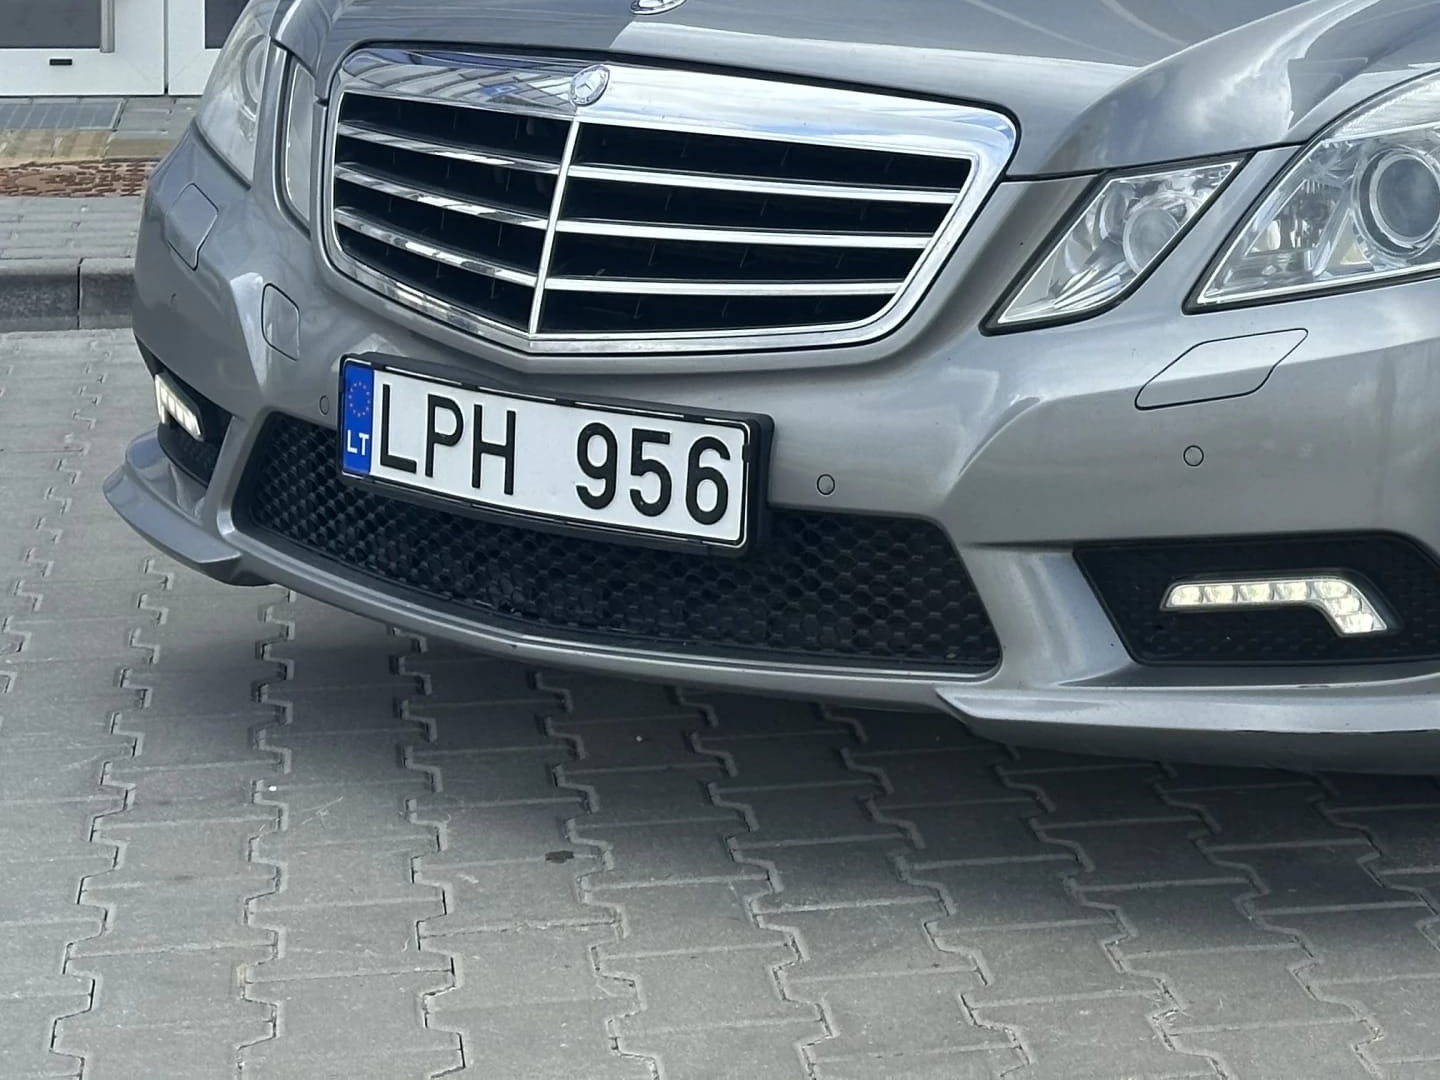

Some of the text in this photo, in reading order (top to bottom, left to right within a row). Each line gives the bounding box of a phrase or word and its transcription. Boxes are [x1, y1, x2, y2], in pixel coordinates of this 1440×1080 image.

[346, 429, 370, 457] LT
[379, 383, 731, 526] LPH 956
